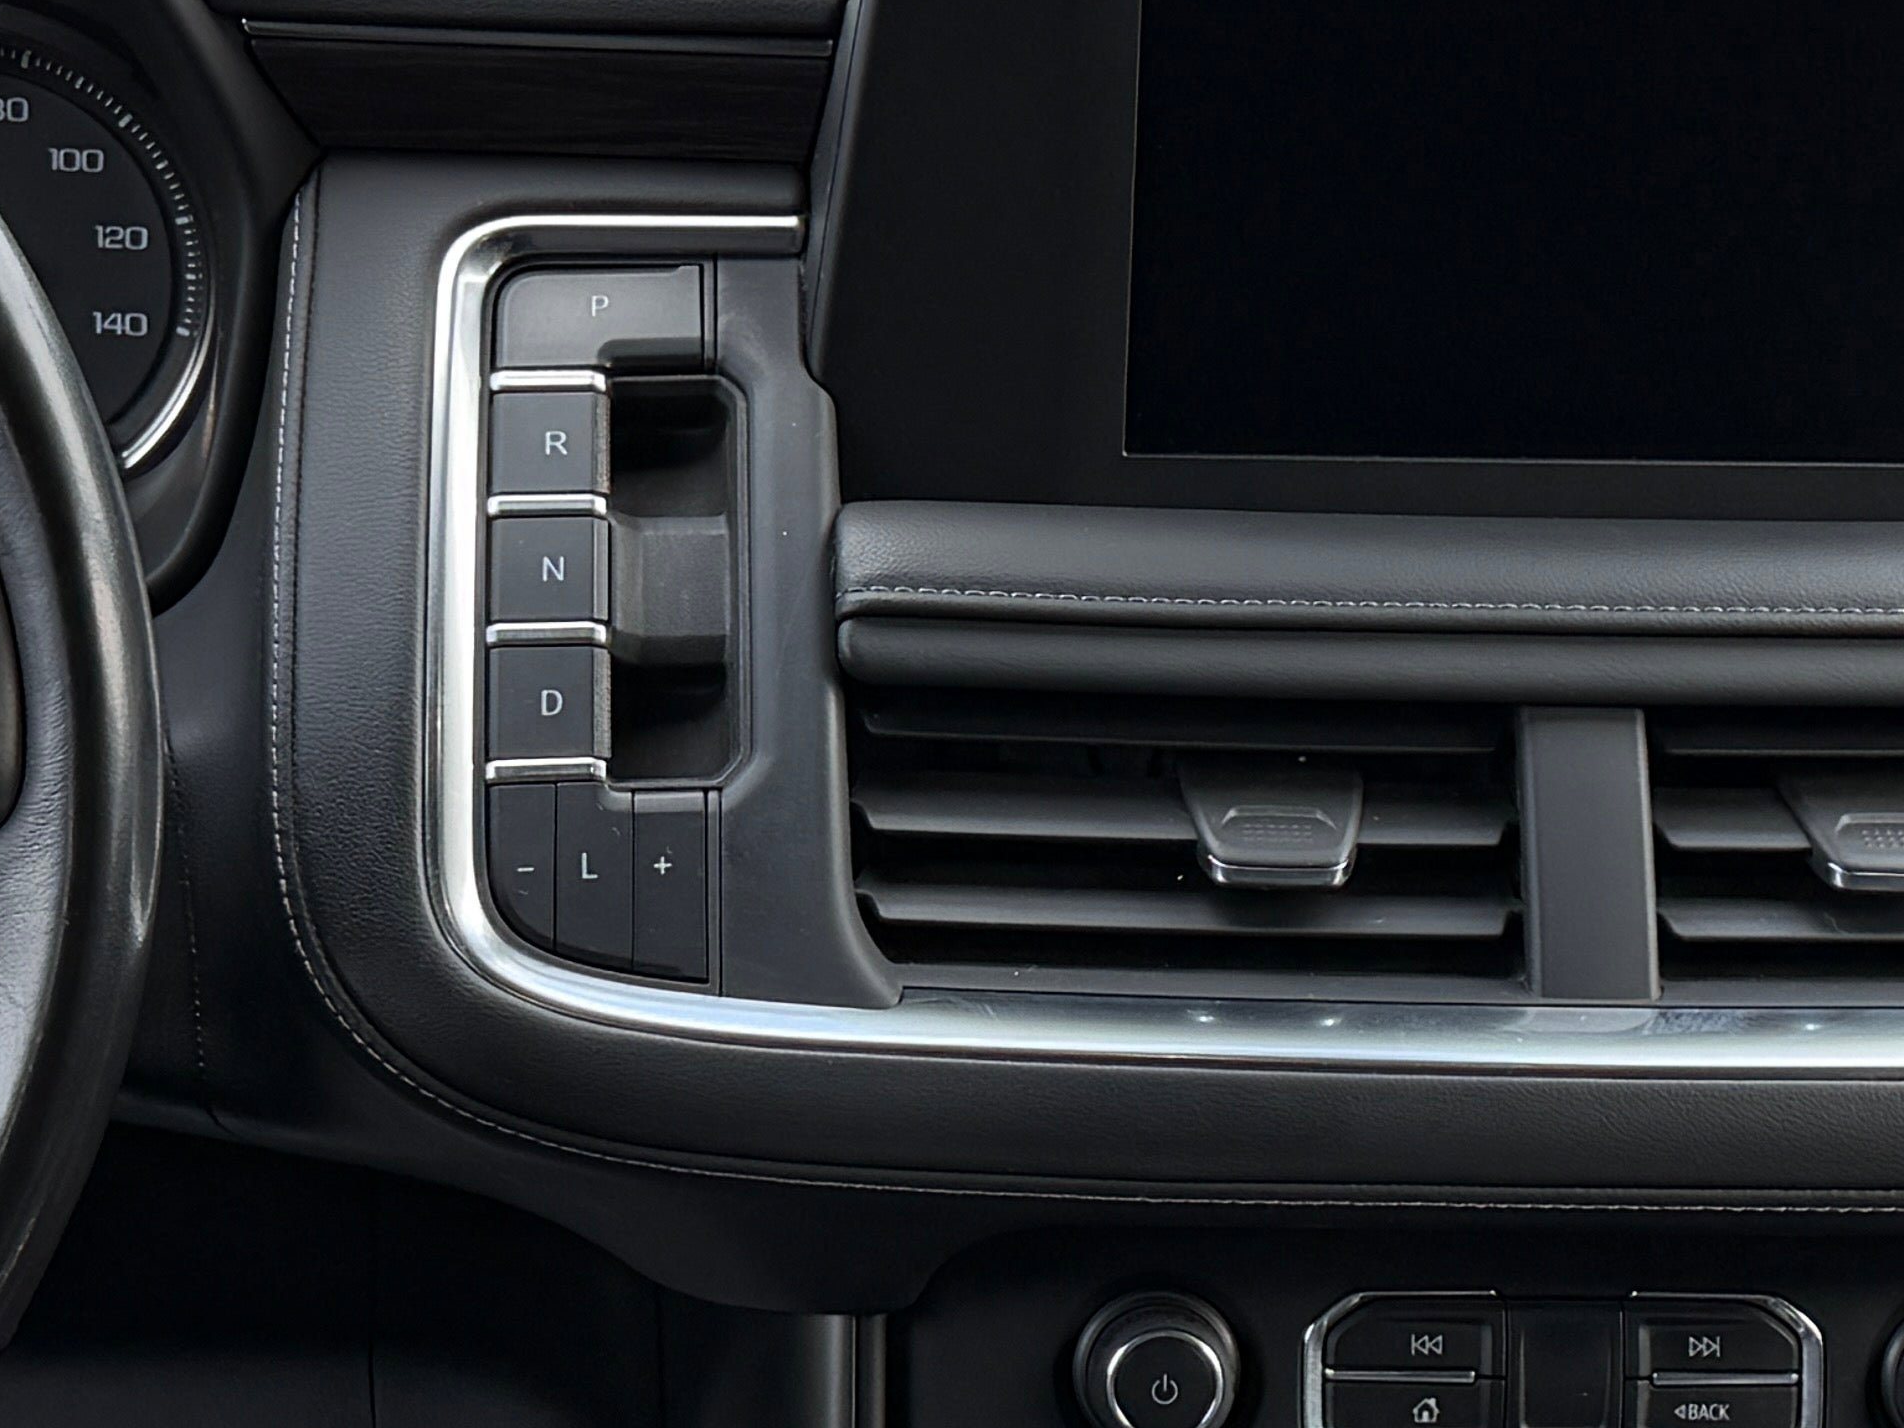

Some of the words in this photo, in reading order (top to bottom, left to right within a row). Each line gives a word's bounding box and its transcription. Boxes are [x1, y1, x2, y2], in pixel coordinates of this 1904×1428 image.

[48, 147, 105, 174] 100
[94, 225, 149, 252] 120
[589, 295, 610, 319] P
[93, 311, 149, 338] 140
[545, 431, 569, 456] R
[541, 556, 565, 581] N
[540, 691, 564, 716] D
[581, 853, 599, 879] L
[1688, 1403, 1730, 1421] BACK
